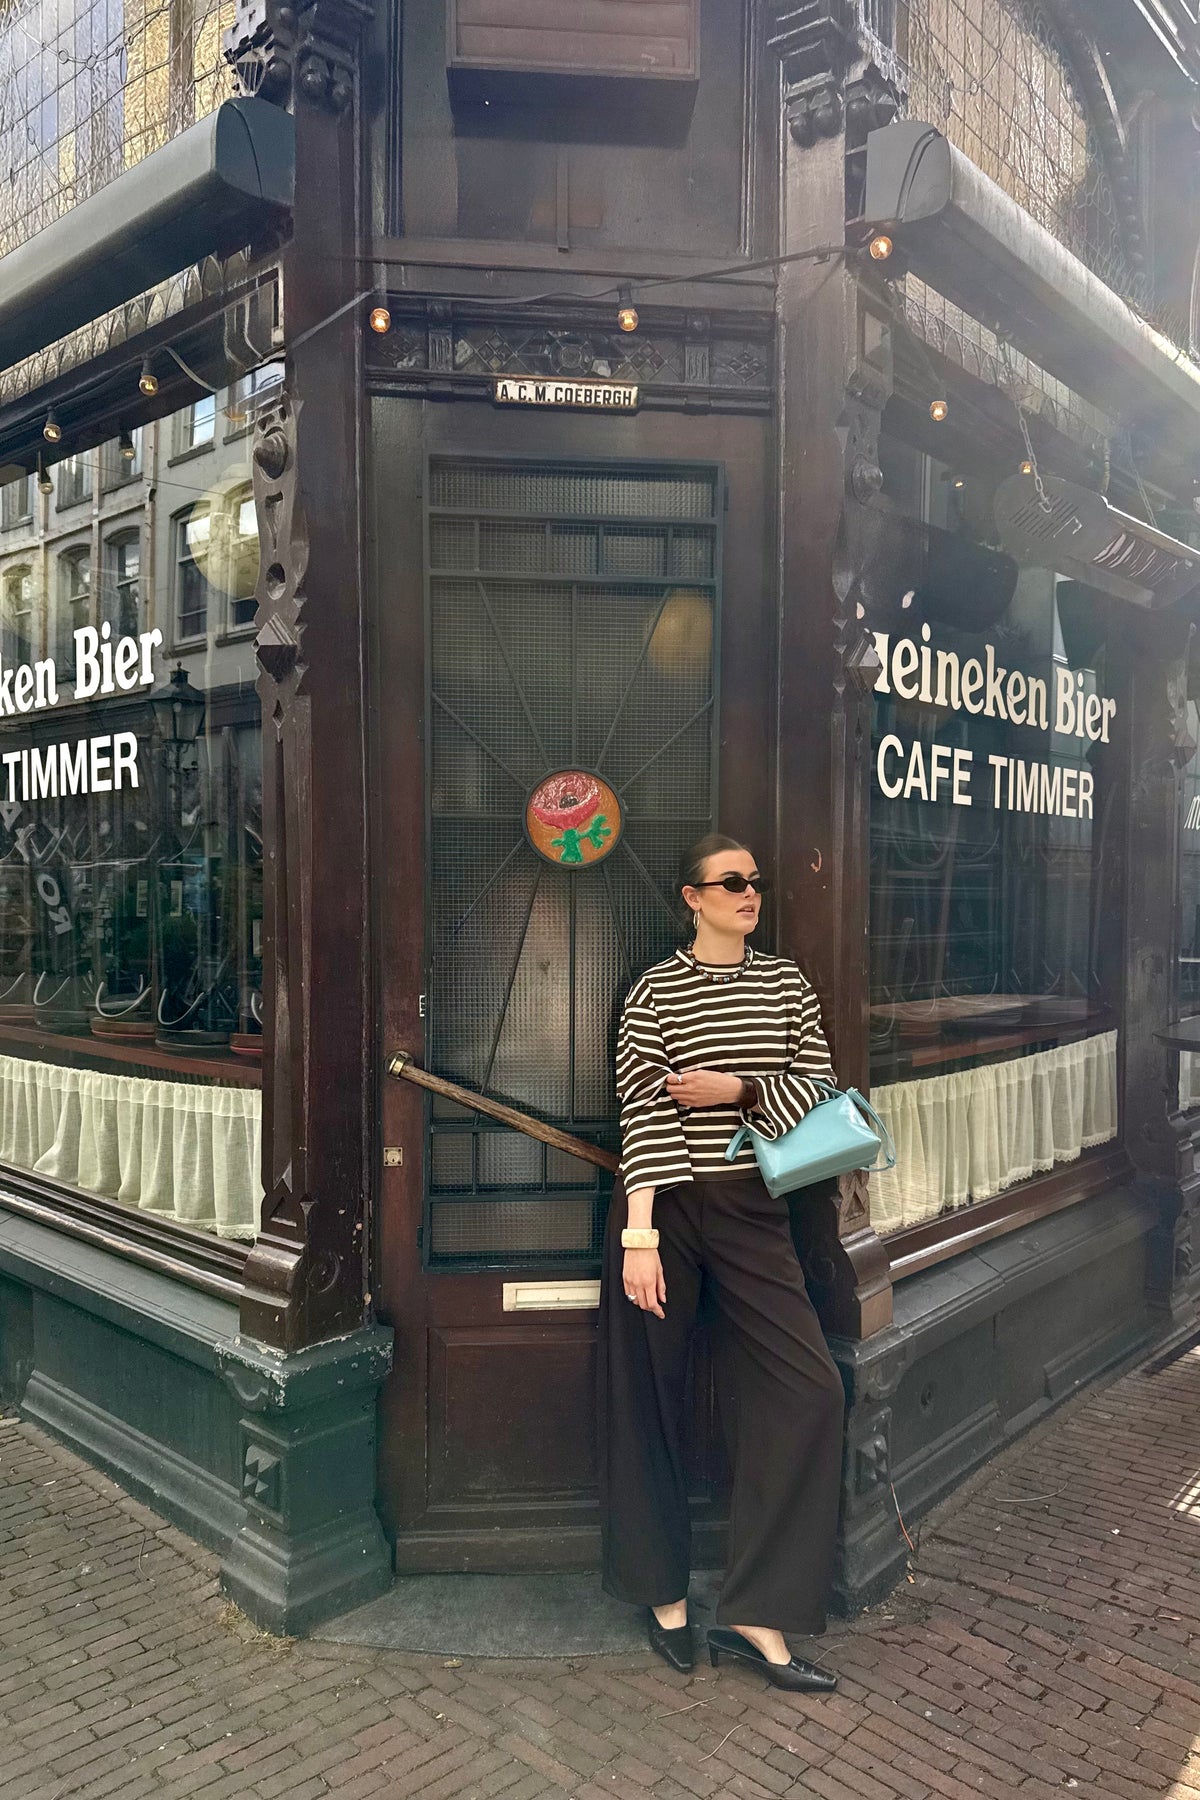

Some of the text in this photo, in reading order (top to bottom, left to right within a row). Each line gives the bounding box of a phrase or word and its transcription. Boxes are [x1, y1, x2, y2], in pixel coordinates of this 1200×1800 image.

[554, 387, 633, 406] COEBERGH
[73, 621, 163, 700] Bier
[1054, 666, 1116, 744] Bier
[2, 731, 140, 803] TIMMER
[876, 734, 1094, 820] CAFE TIMMER
